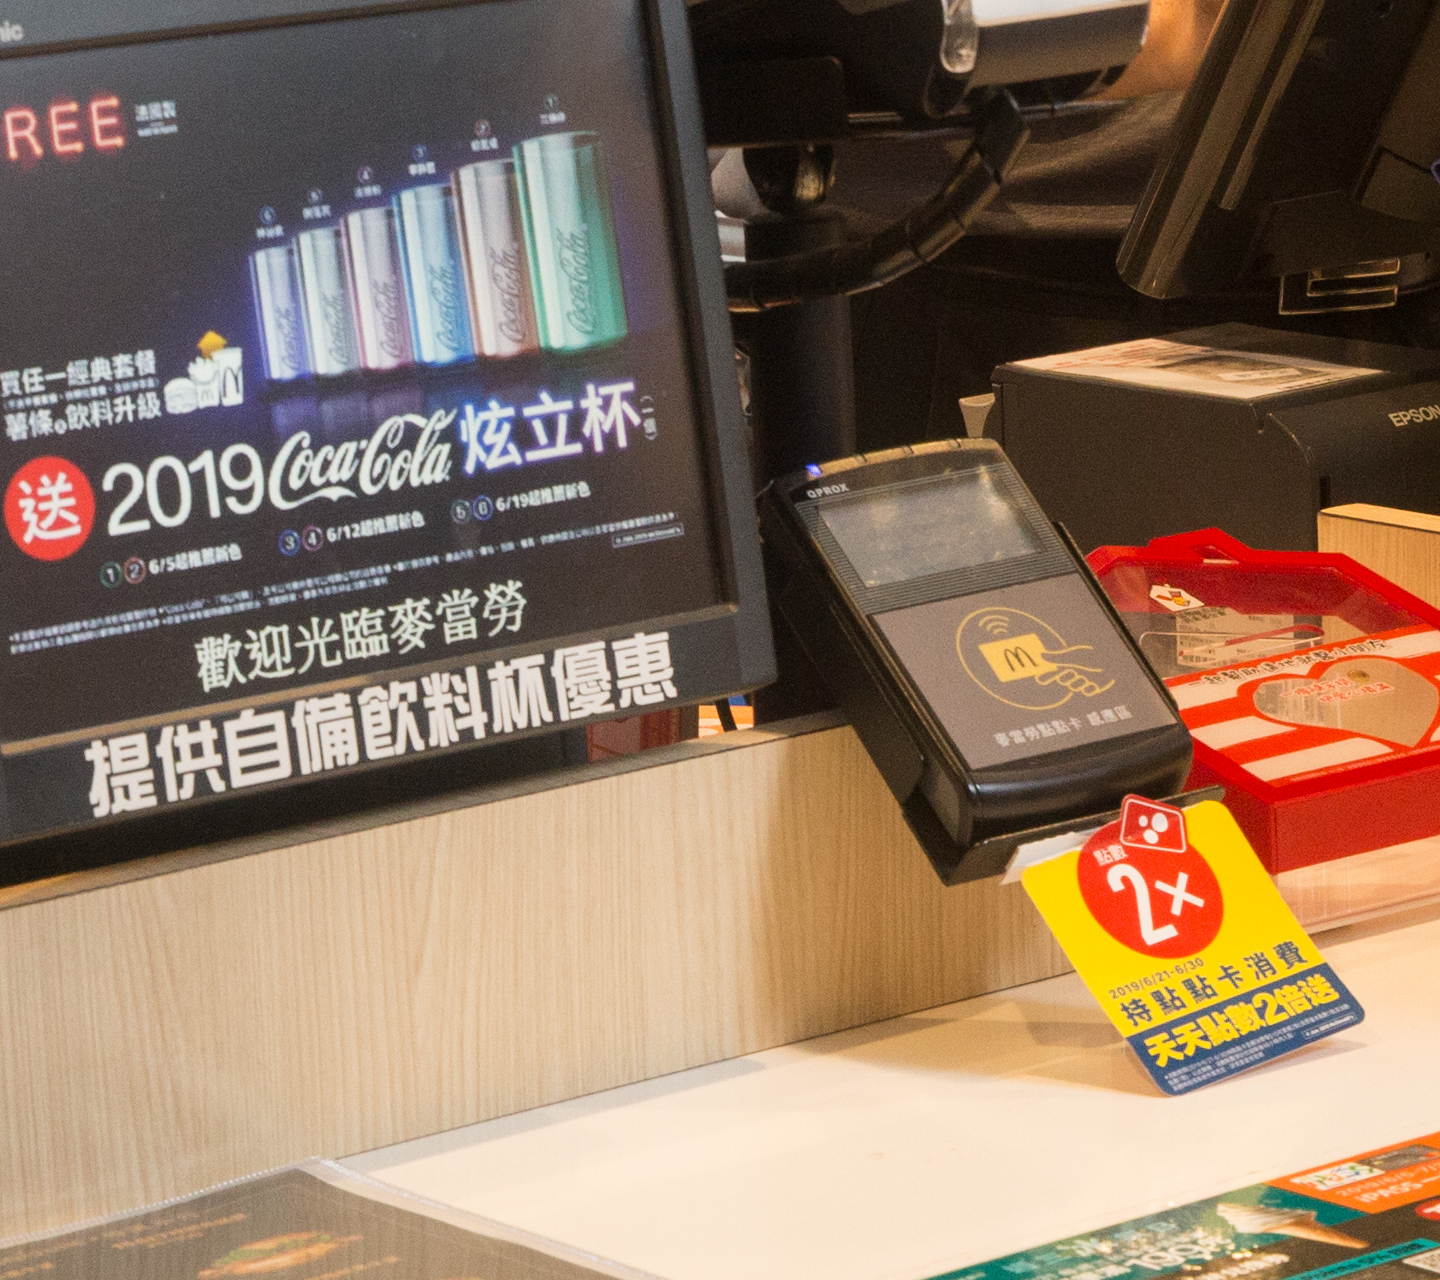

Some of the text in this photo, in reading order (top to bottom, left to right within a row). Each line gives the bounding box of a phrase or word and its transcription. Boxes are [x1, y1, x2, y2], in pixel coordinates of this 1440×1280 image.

[19, 473, 81, 544] 送
[103, 443, 264, 536] 2019
[460, 381, 644, 476] 炫立杯
[196, 581, 528, 693] 歡迎光臨麥當勞
[84, 632, 679, 818] 提供自備飲料杯優惠
[1092, 843, 1128, 866] 點數
[1120, 940, 1308, 1027] 持點點卡消費
[1144, 974, 1340, 1067] 天天點數2倍送
